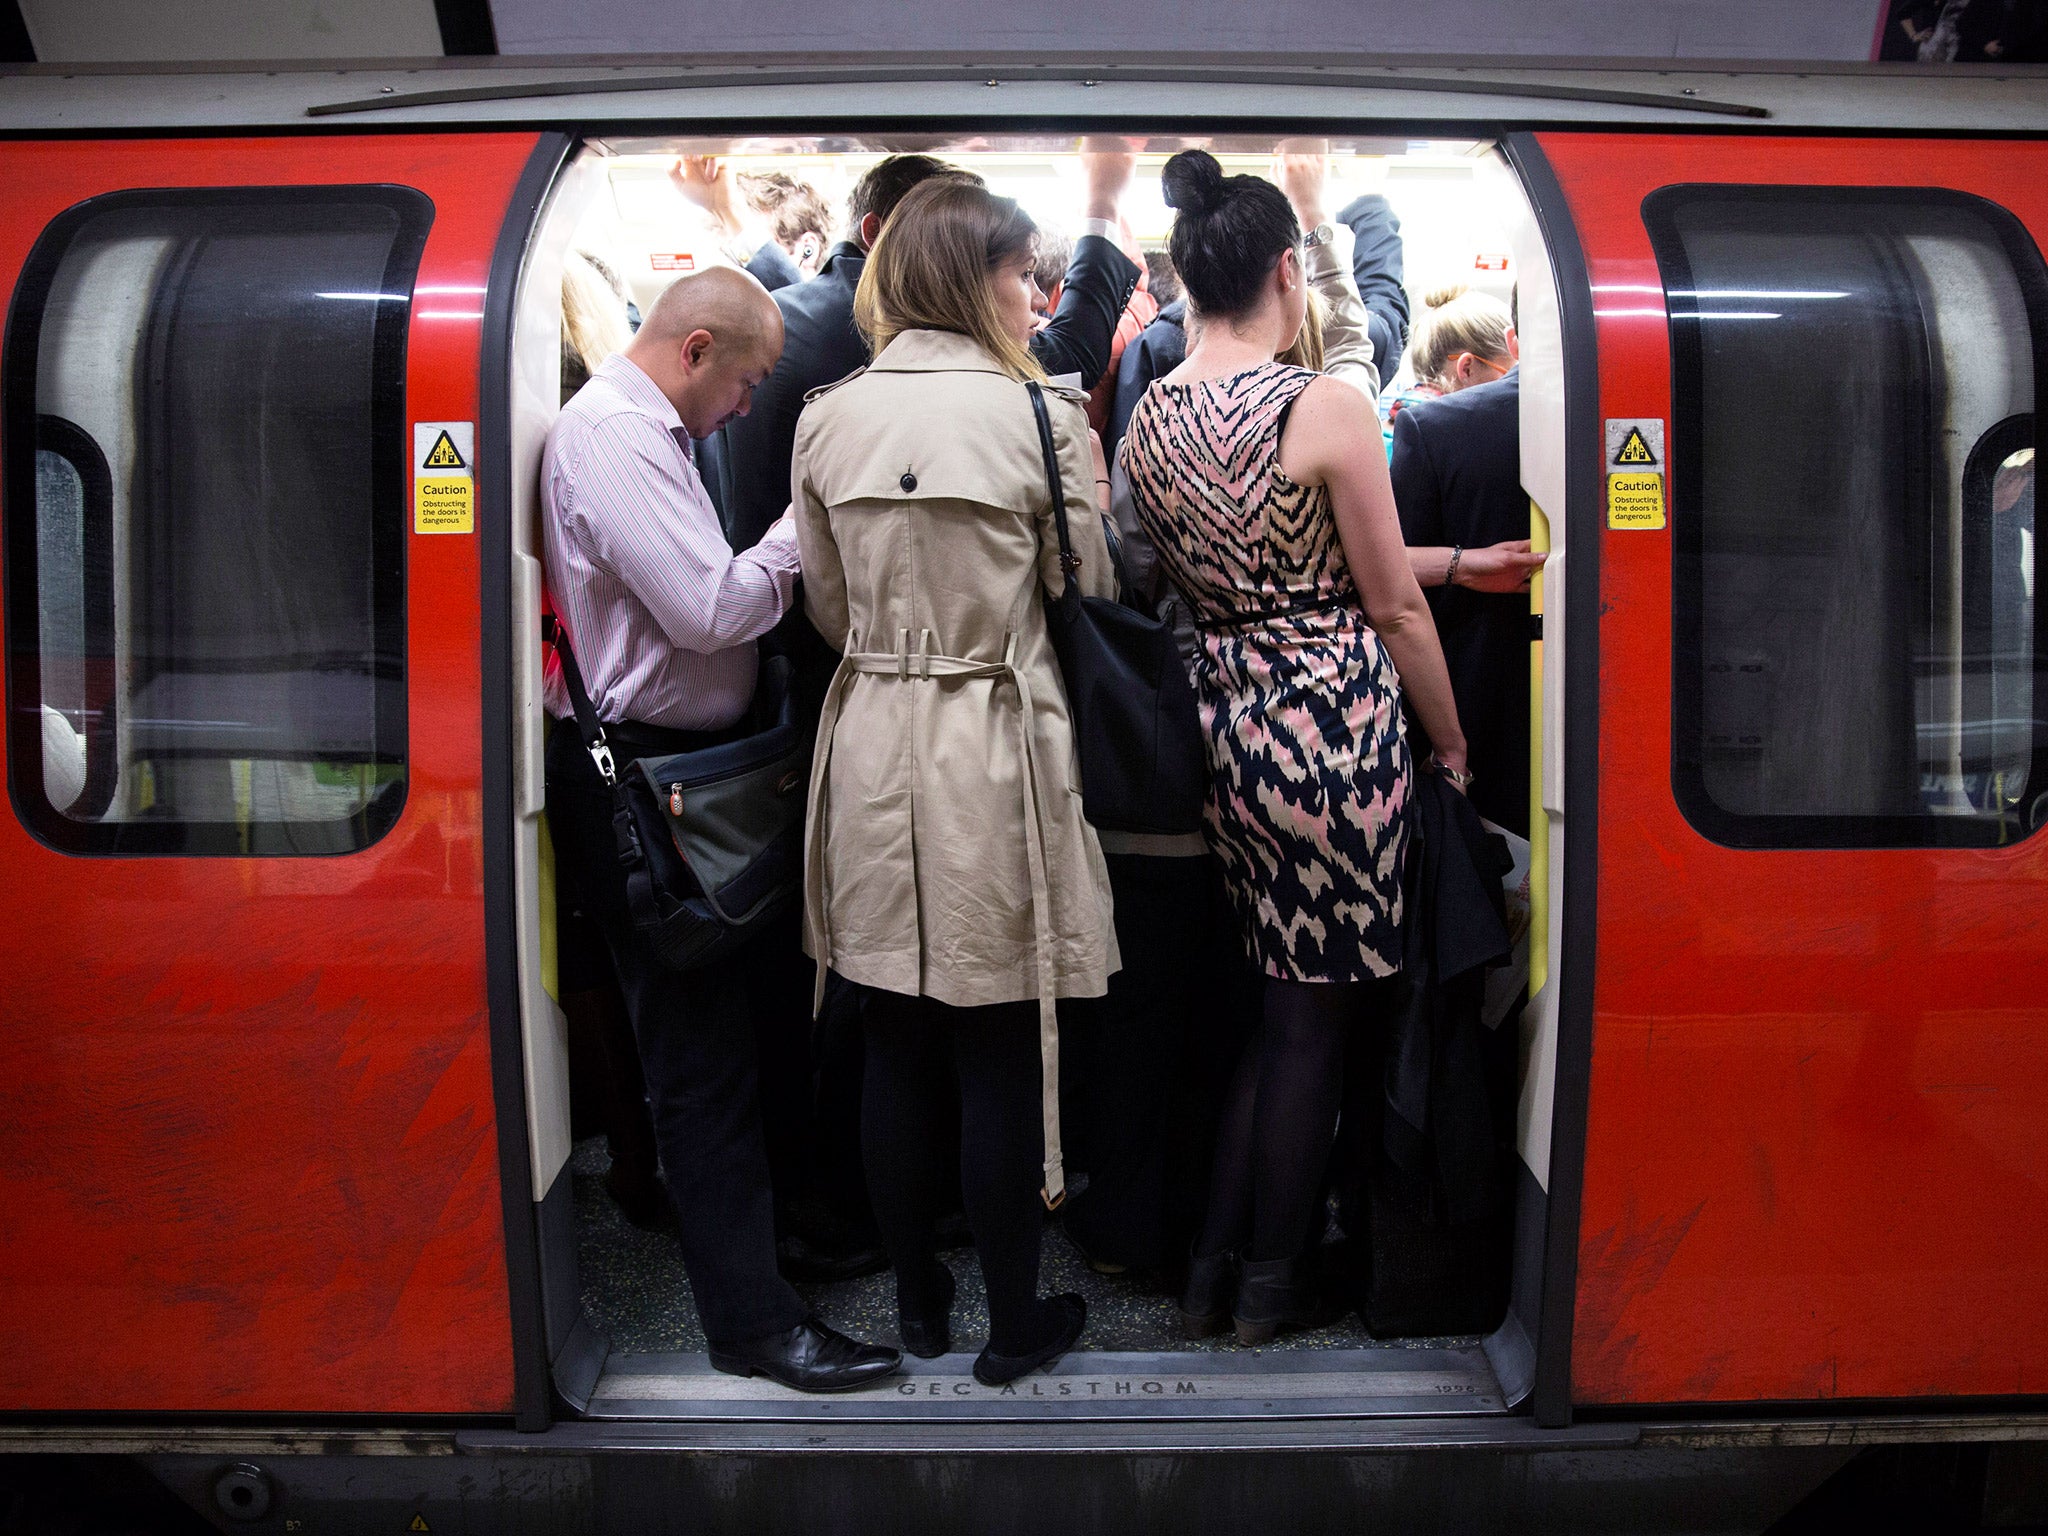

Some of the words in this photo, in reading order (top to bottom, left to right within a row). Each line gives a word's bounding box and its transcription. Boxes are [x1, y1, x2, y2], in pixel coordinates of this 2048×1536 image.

[422, 485, 467, 495] Caution
[1614, 481, 1658, 491] Caution
[422, 500, 466, 508] Obstructing
[1614, 496, 1658, 504] Obstructing
[422, 517, 460, 525] dangerous
[898, 1383, 971, 1395] GEC
[1000, 1381, 1197, 1395] ALSTHOM
